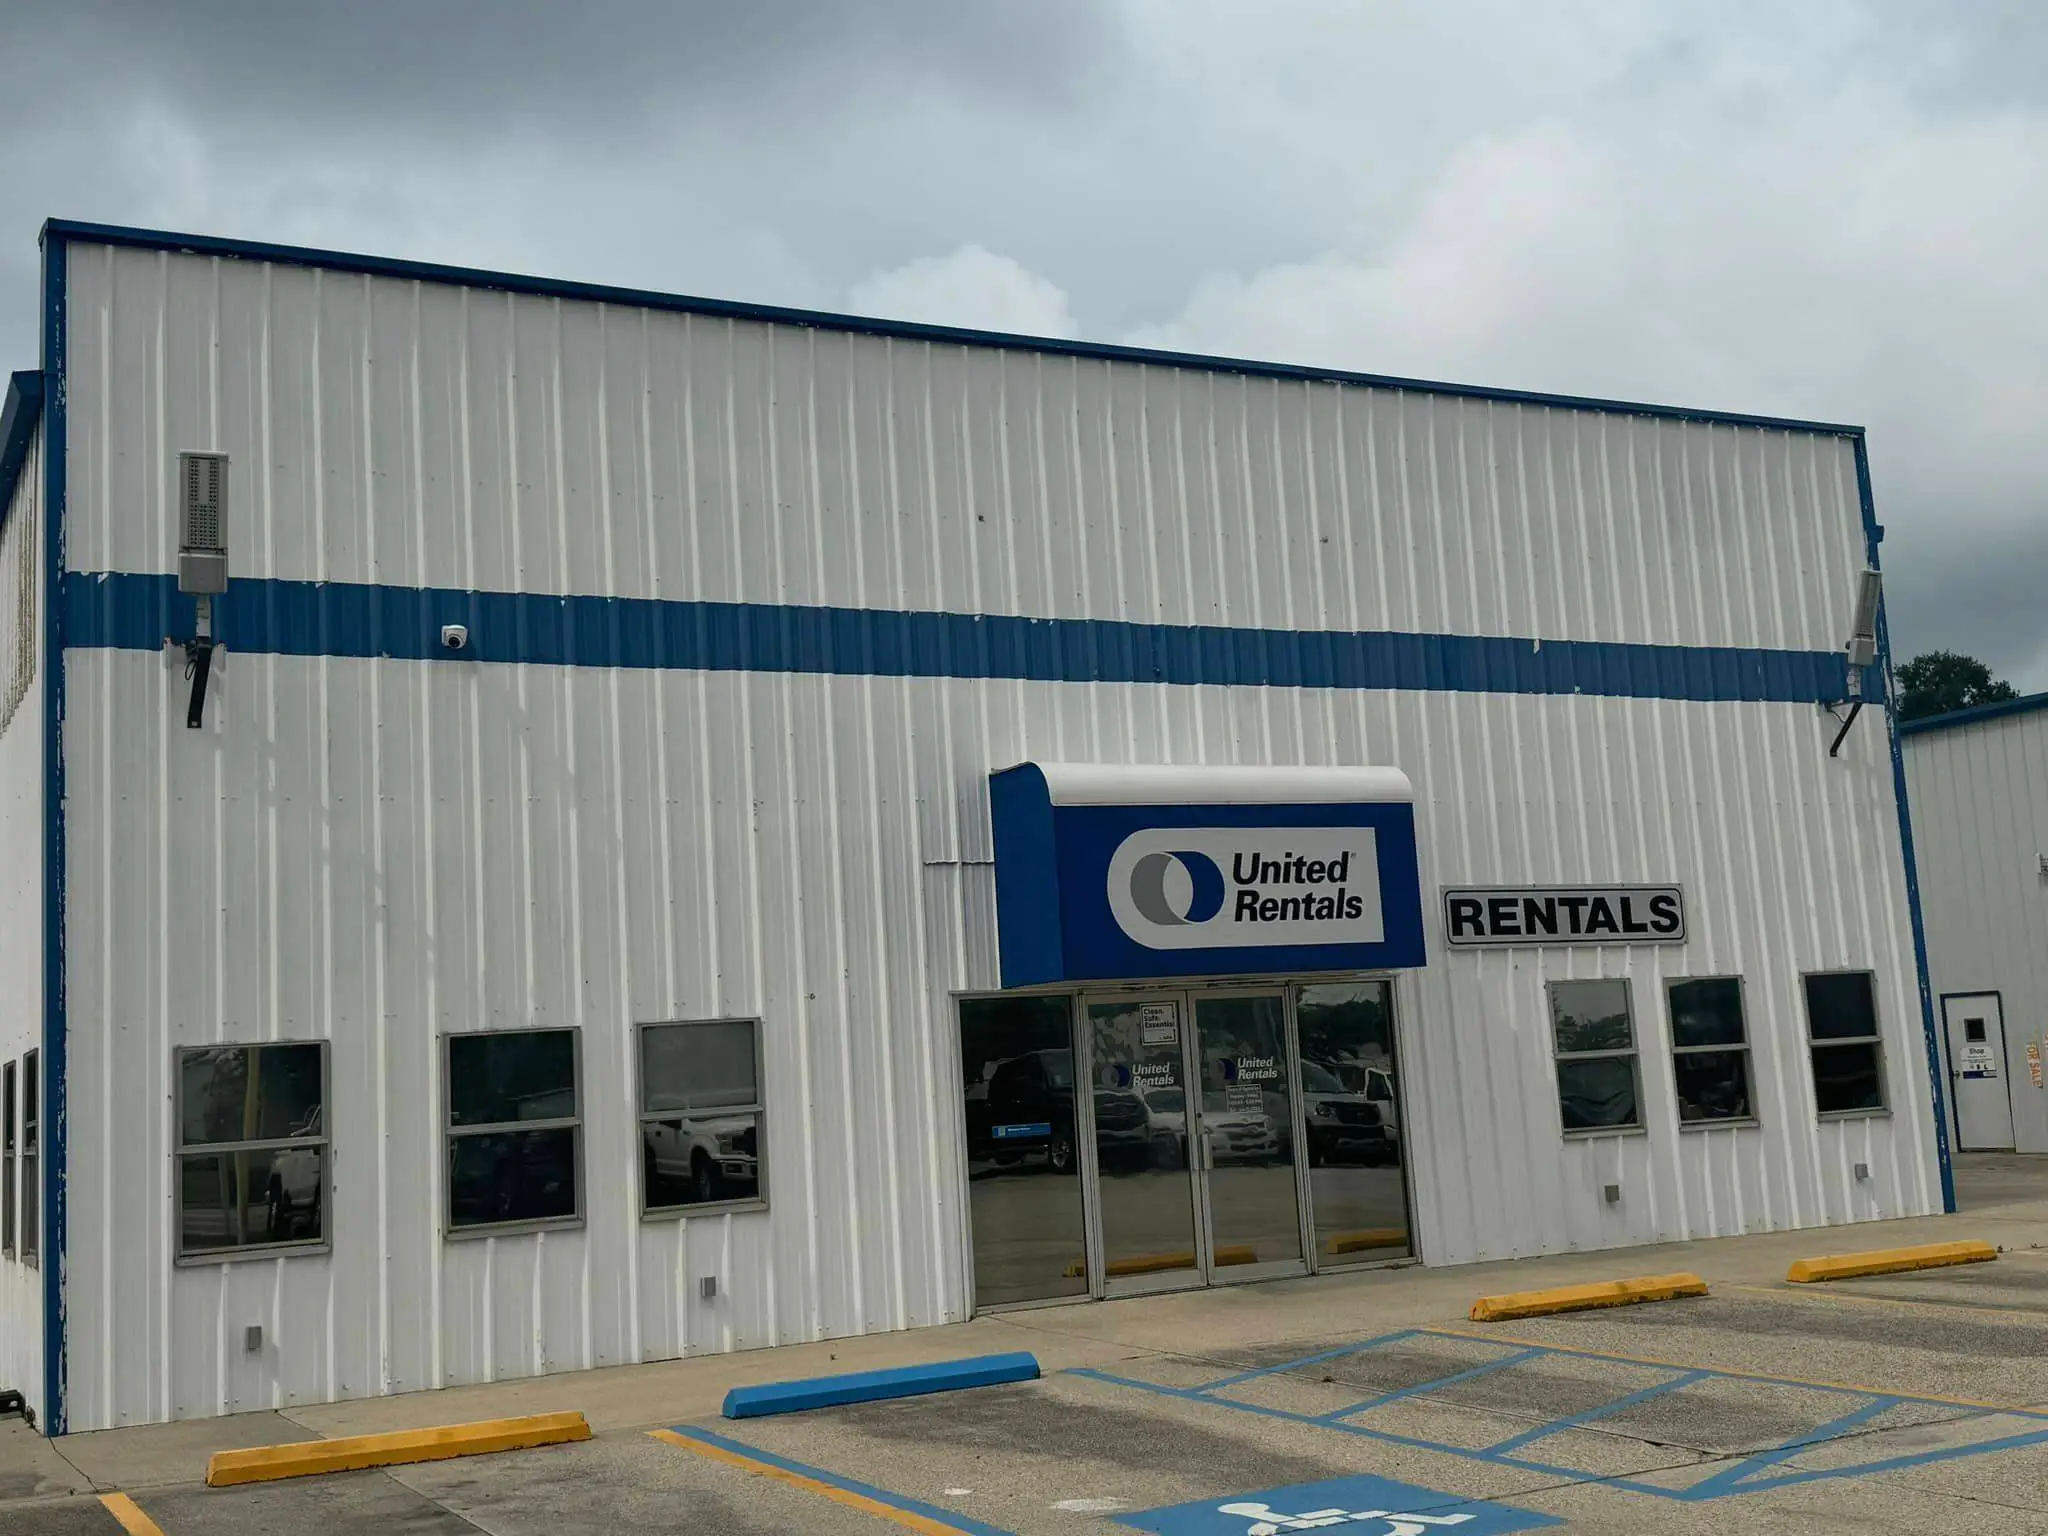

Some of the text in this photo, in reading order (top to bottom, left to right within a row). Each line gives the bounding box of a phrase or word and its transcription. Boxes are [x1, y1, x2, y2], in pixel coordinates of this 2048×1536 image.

[1233, 851, 1349, 885] United
[1234, 887, 1363, 922] Rentals
[1449, 895, 1680, 937] RENTALS
[1132, 1062, 1171, 1075] United
[1237, 1056, 1274, 1069] United
[1238, 1067, 1278, 1080] Rentals
[1133, 1074, 1175, 1087] Rentals
